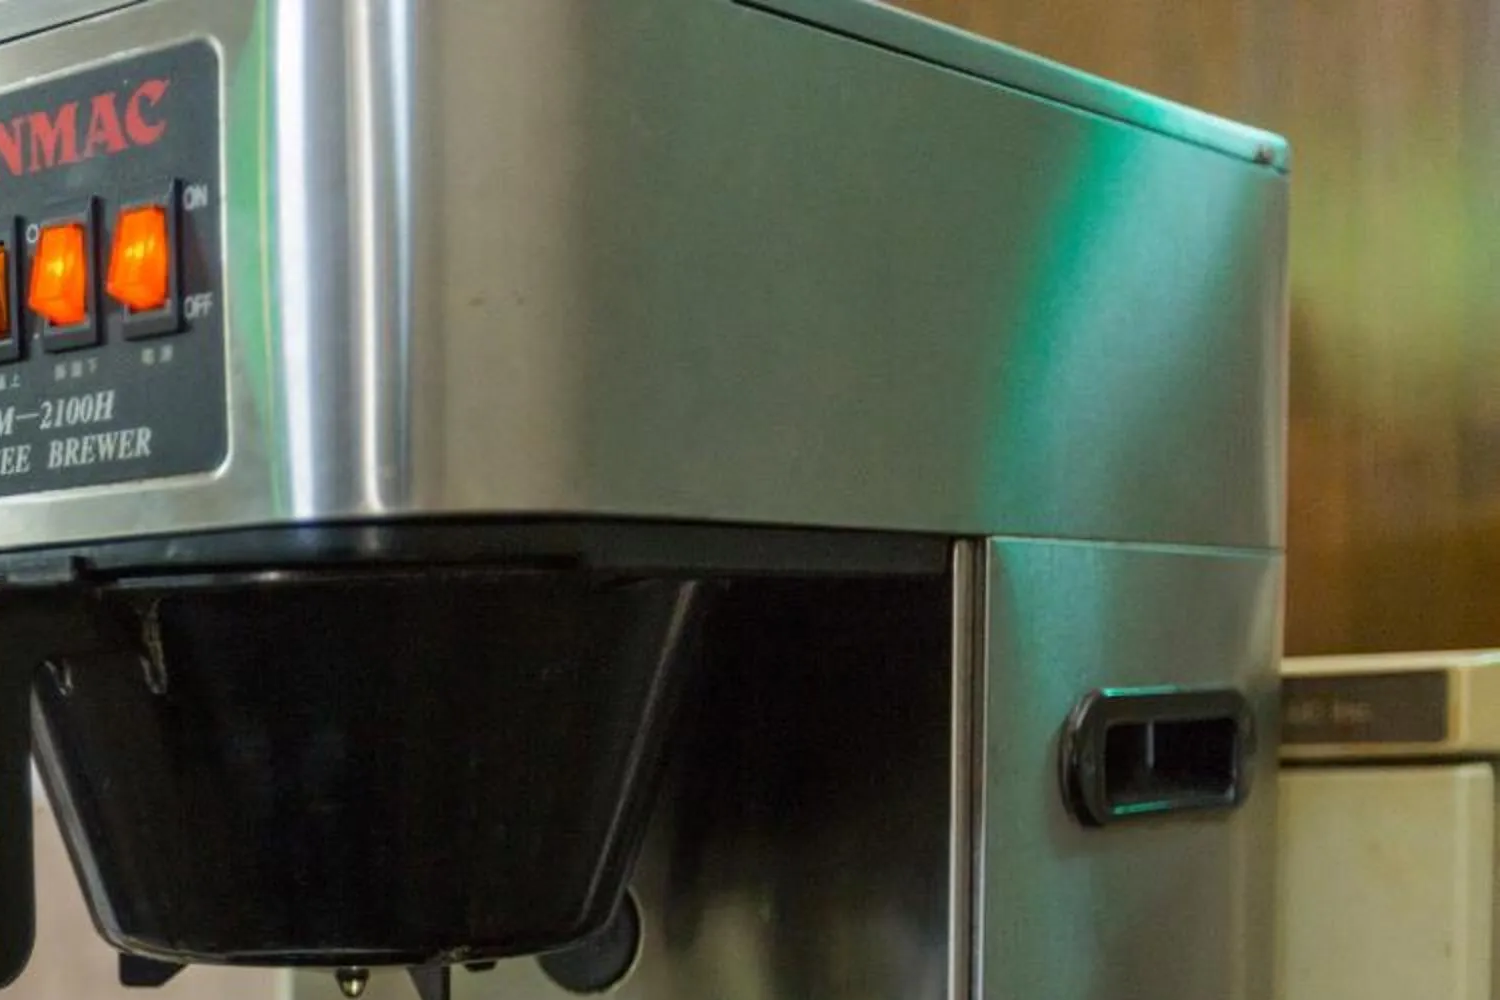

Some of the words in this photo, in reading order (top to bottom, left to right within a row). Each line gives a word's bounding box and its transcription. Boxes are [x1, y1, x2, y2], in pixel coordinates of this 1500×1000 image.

[183, 184, 208, 211] ON
[184, 292, 213, 320] OFF
[48, 426, 152, 469] BREWER
